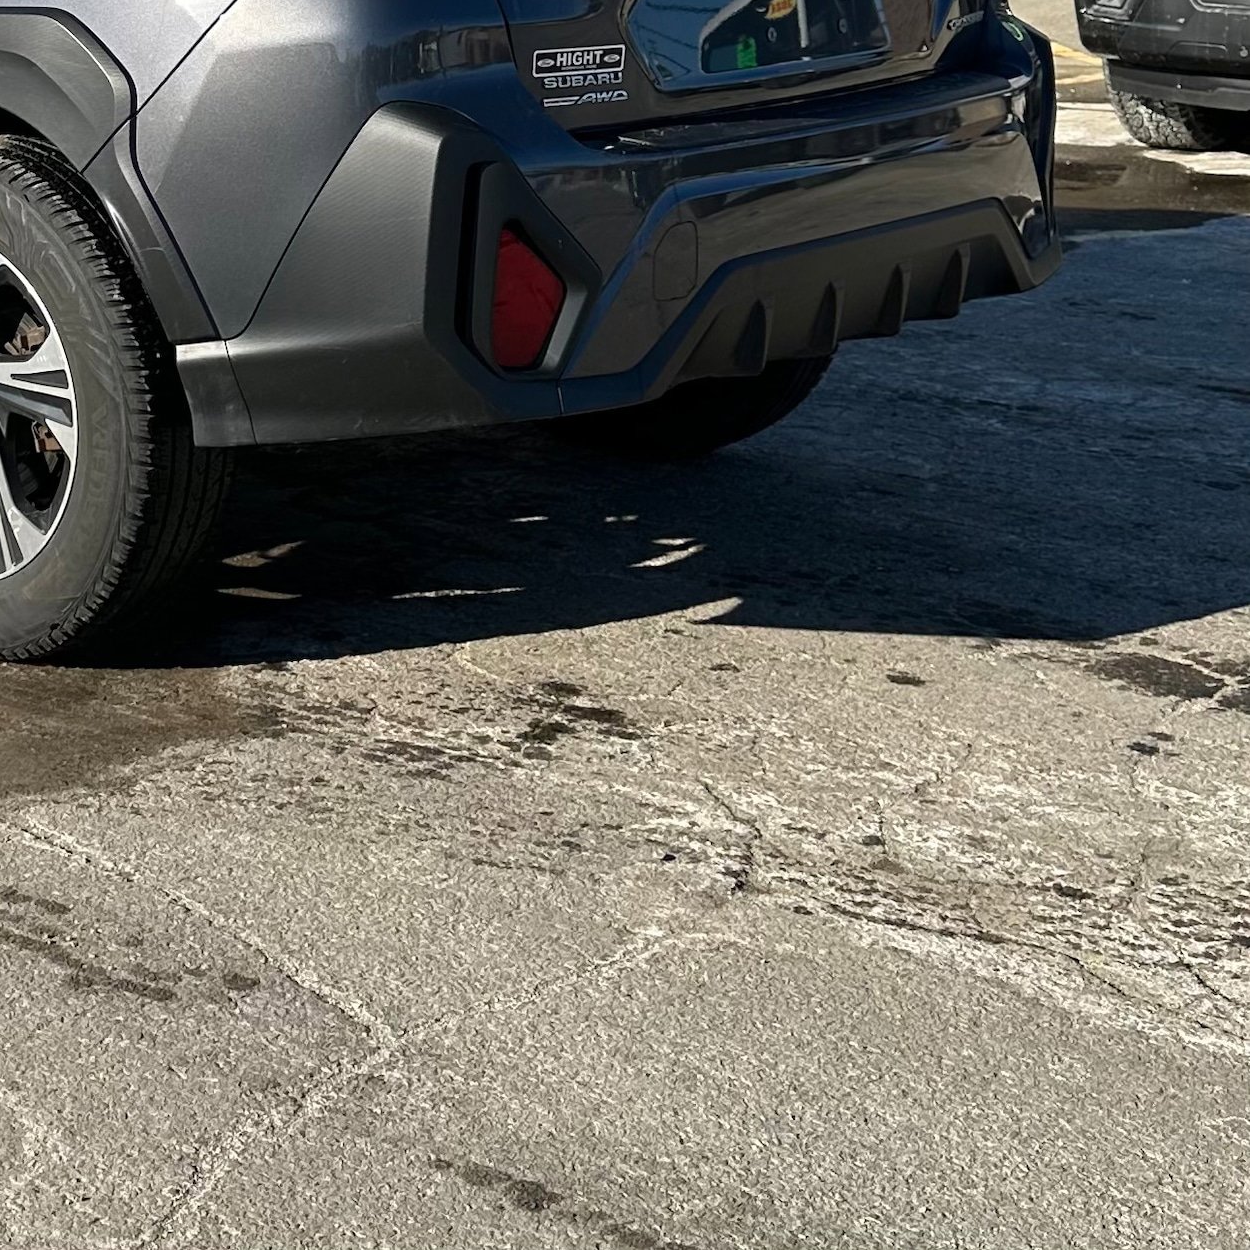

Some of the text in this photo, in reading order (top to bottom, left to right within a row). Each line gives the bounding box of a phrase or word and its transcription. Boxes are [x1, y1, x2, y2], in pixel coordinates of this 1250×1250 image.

[556, 50, 604, 67] HIGHT
[543, 71, 623, 89] SUBARU
[576, 90, 629, 105] AWD
